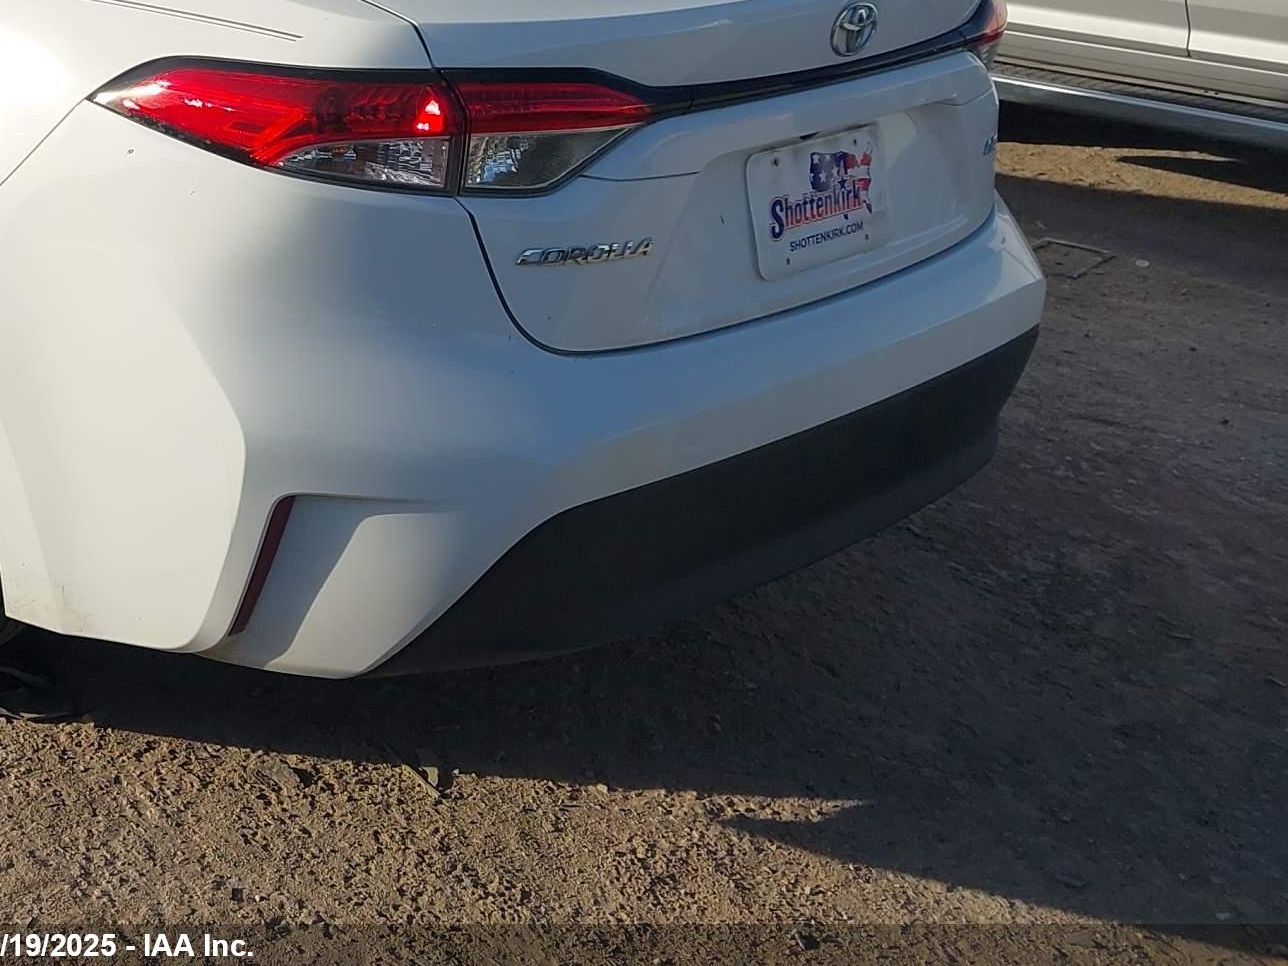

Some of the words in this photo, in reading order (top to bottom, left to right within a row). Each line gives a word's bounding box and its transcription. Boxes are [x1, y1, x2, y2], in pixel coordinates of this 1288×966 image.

[771, 179, 864, 240] Shottenkirk
[515, 236, 655, 266] COROLLA
[789, 220, 864, 252] SHOTTENKIRK.COM
